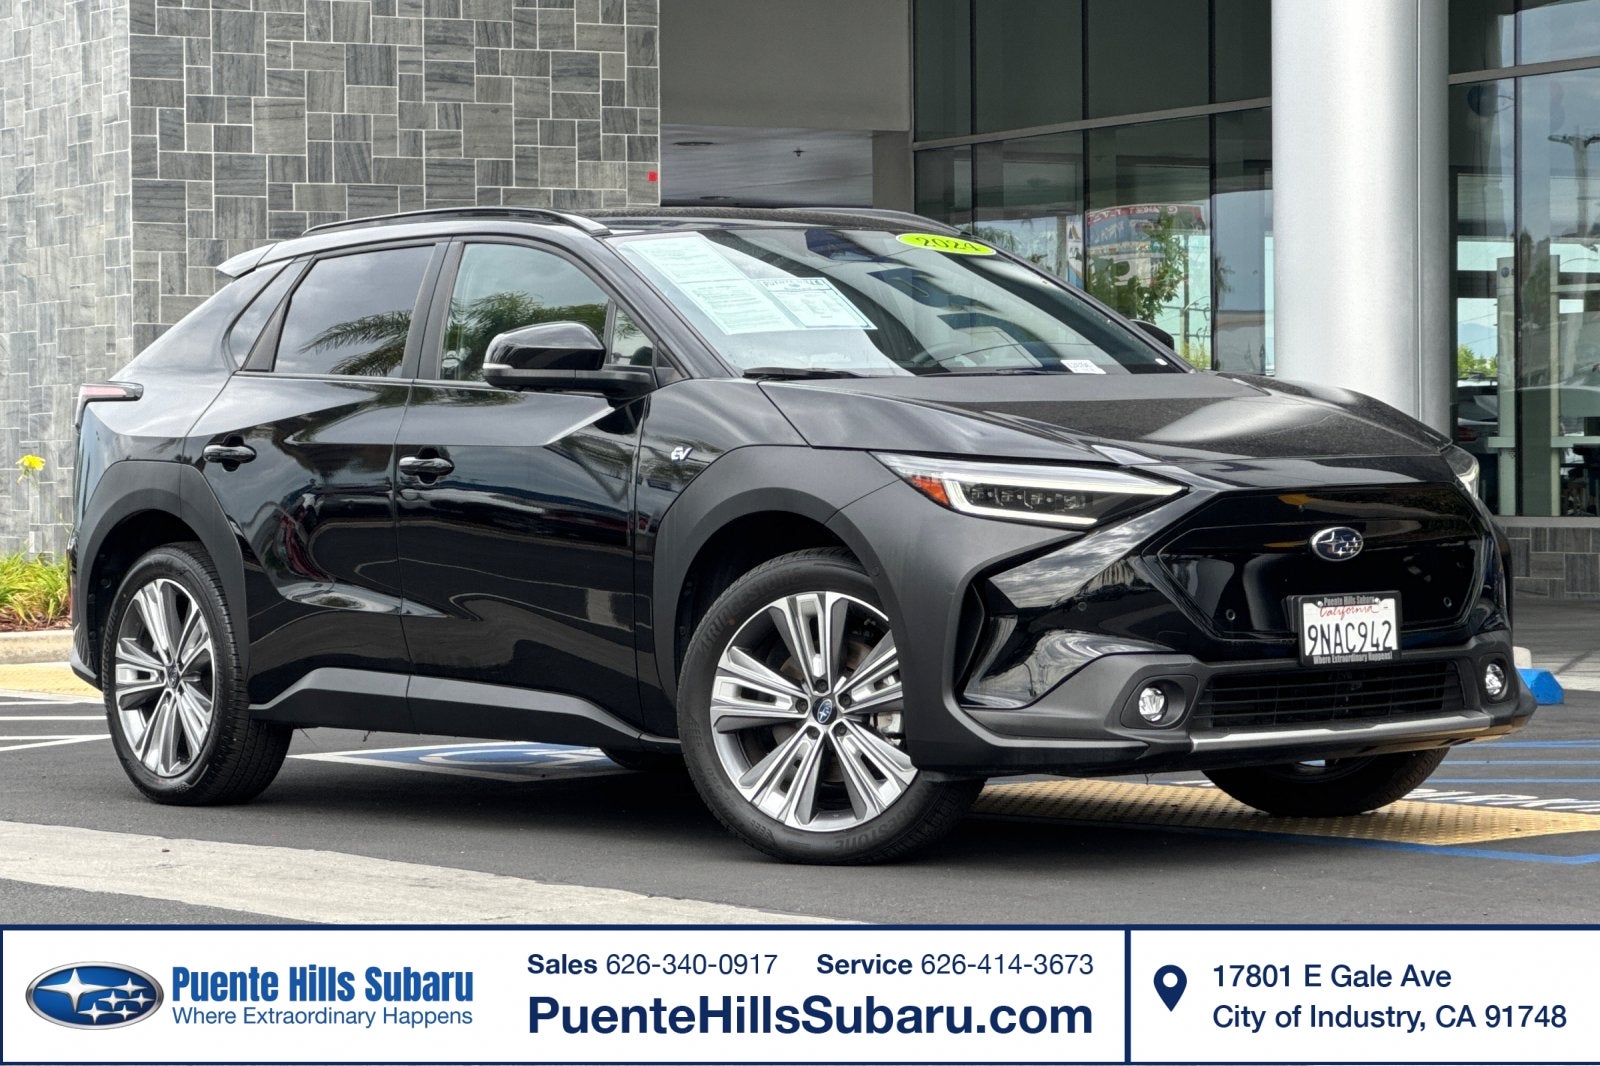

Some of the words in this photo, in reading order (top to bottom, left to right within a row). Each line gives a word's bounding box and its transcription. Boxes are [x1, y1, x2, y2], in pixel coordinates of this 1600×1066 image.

[914, 236, 981, 252] 2024
[1343, 596, 1356, 605] Hills
[1320, 605, 1379, 620] California
[1308, 620, 1392, 655] 9NAC942
[1313, 655, 1331, 664] Where
[1331, 653, 1367, 663] Extraordinary
